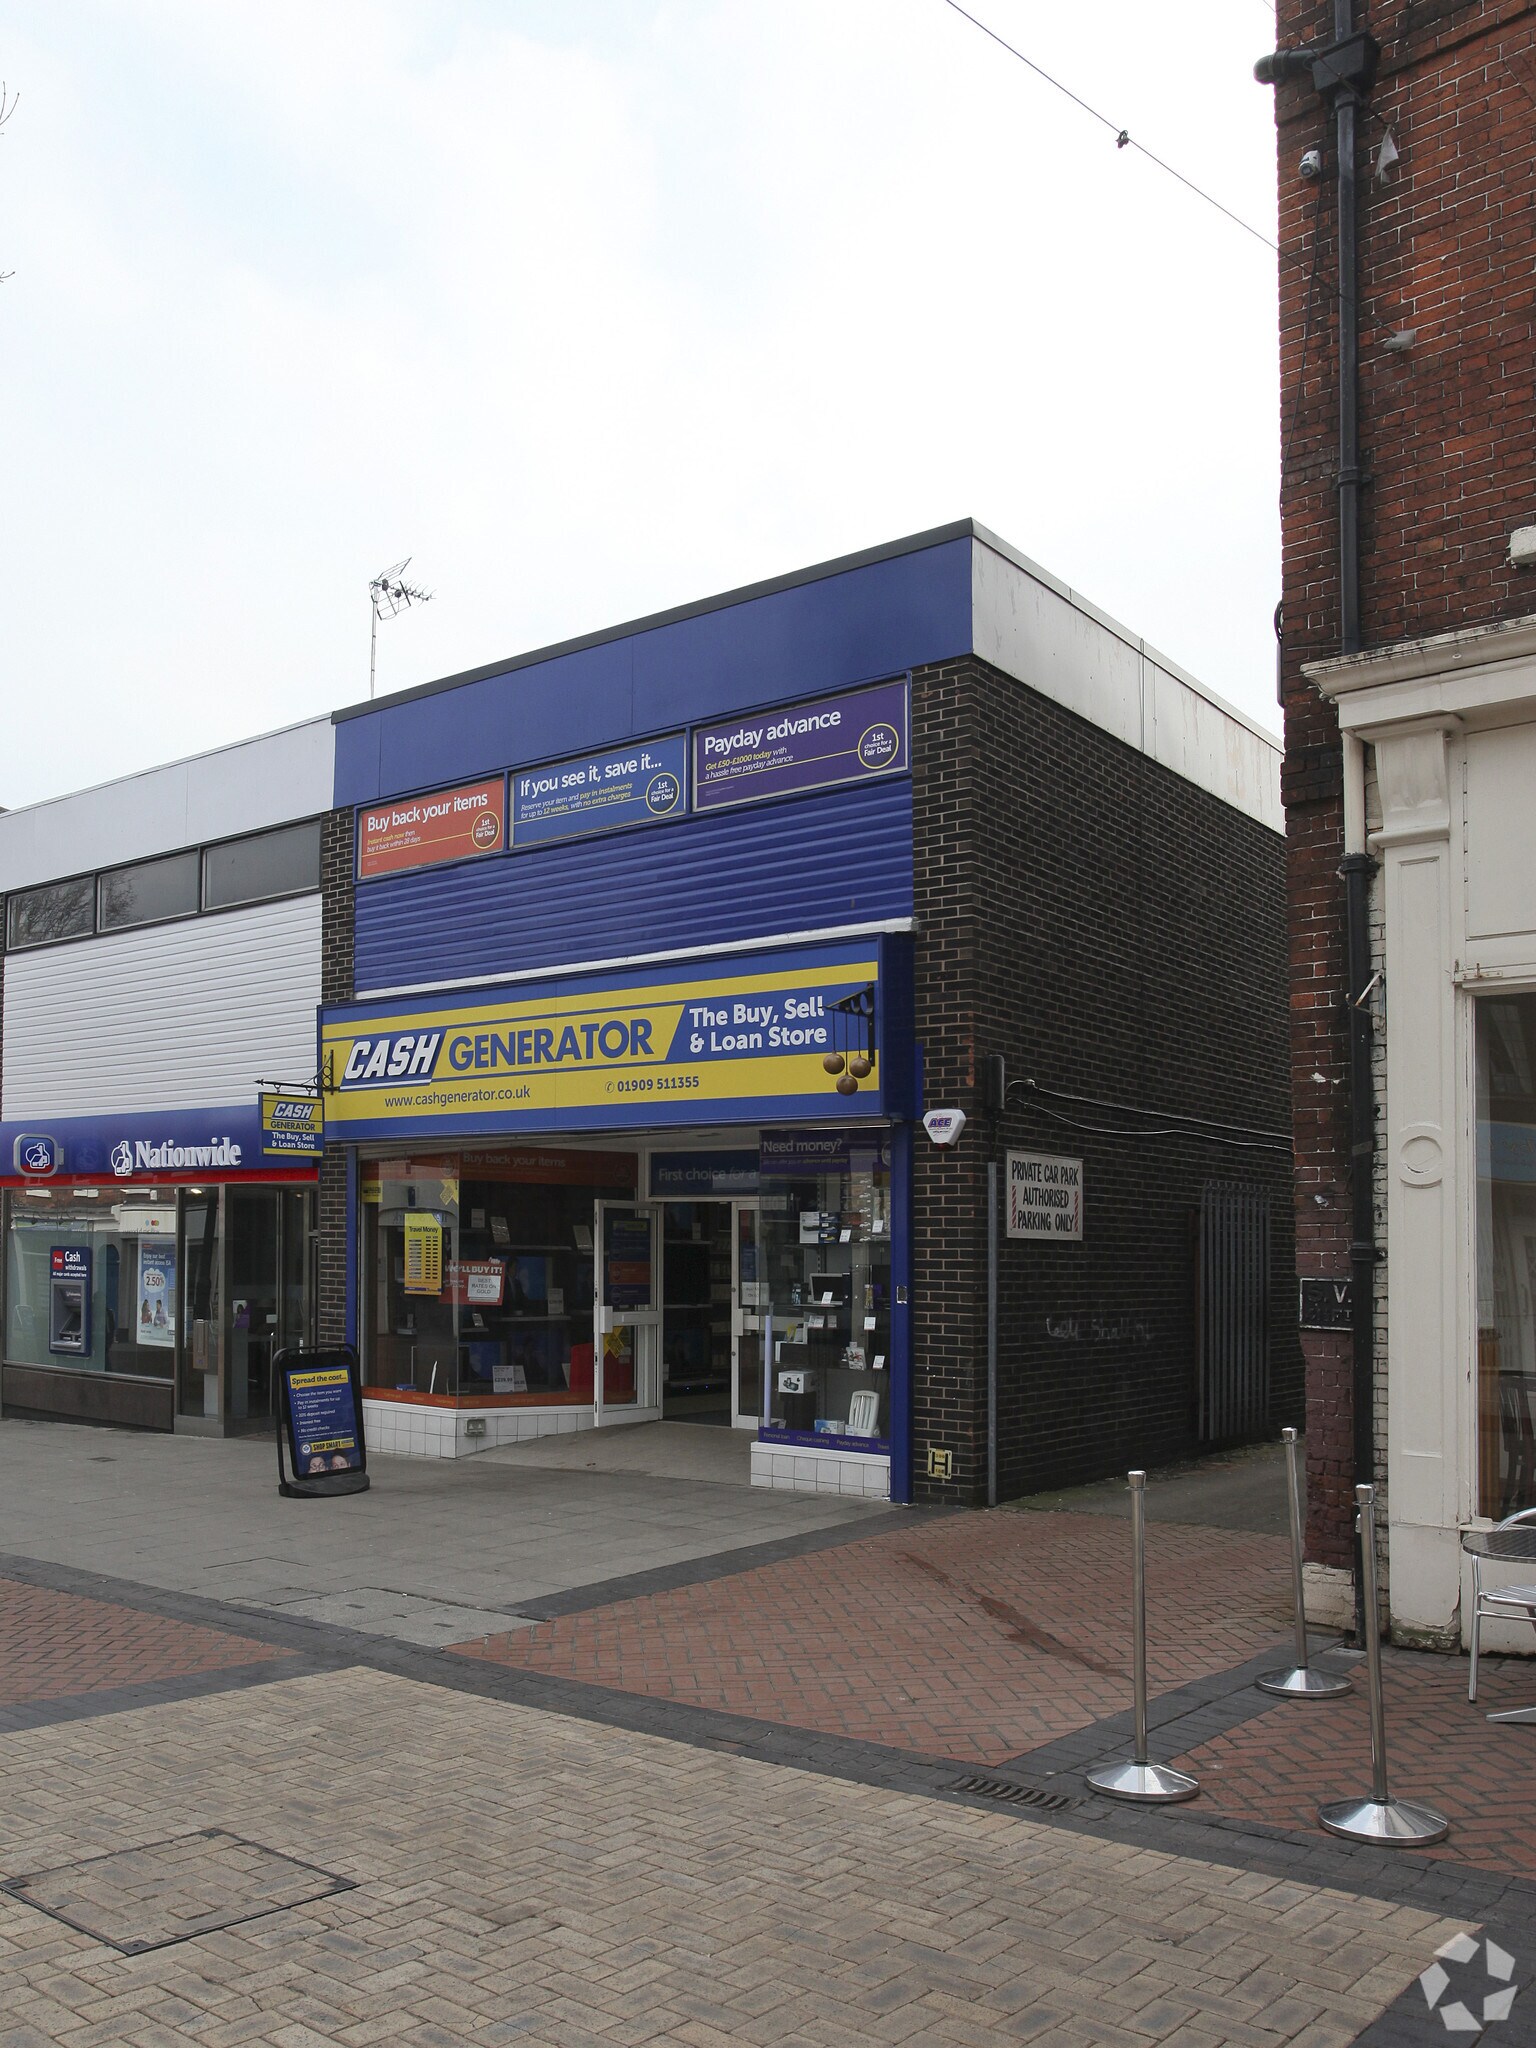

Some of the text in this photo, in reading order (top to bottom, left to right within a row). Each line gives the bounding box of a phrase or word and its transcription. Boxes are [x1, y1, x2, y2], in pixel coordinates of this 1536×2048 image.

[705, 711, 841, 755] Payday advance
[872, 732, 884, 742] 1st
[876, 745, 892, 754] Deal
[706, 762, 717, 771] Get
[753, 751, 771, 760] today
[773, 746, 788, 756] with
[710, 768, 730, 778] hassle
[730, 766, 742, 774] free
[743, 760, 766, 774] payday
[766, 755, 793, 766] advance
[520, 754, 662, 798] If you see it, save it...
[658, 781, 668, 790] 1st
[521, 802, 542, 812] Reserve
[542, 801, 554, 810] your
[555, 796, 568, 805] item
[568, 794, 579, 802] and
[580, 792, 591, 800] pay
[599, 782, 632, 796] instalments
[662, 792, 674, 800] Deal
[368, 794, 488, 832] Buy back your items
[528, 811, 536, 819] up
[570, 801, 582, 810] with
[592, 796, 606, 805] extra
[607, 791, 631, 803] charges
[482, 818, 490, 826] 1st
[689, 996, 824, 1028] The Buy, Sell
[344, 1018, 827, 1080] CASH GENERATOR & Loan Store
[384, 1076, 700, 1108] www.cashgenerator.co.uk 01909 511355
[274, 1104, 314, 1118] CASH
[270, 1120, 316, 1131] GENERATOR
[272, 1132, 285, 1140] The
[286, 1132, 302, 1142] Buy,
[278, 1140, 296, 1148] Loan
[297, 1142, 315, 1150] Store
[134, 1137, 242, 1169] Nationwide
[763, 1138, 843, 1154] Need money?
[463, 1152, 566, 1168] Buy back your items
[658, 1168, 684, 1181] First
[686, 1167, 726, 1180] choice
[1012, 1160, 1079, 1186] PRIVATE CAR PARK
[1022, 1186, 1069, 1208] AUTHORISED
[1018, 1210, 1074, 1232] PARKING ONLY
[64, 1251, 80, 1262] Cash
[292, 1376, 316, 1385] Spread
[326, 1440, 340, 1449] SMART
